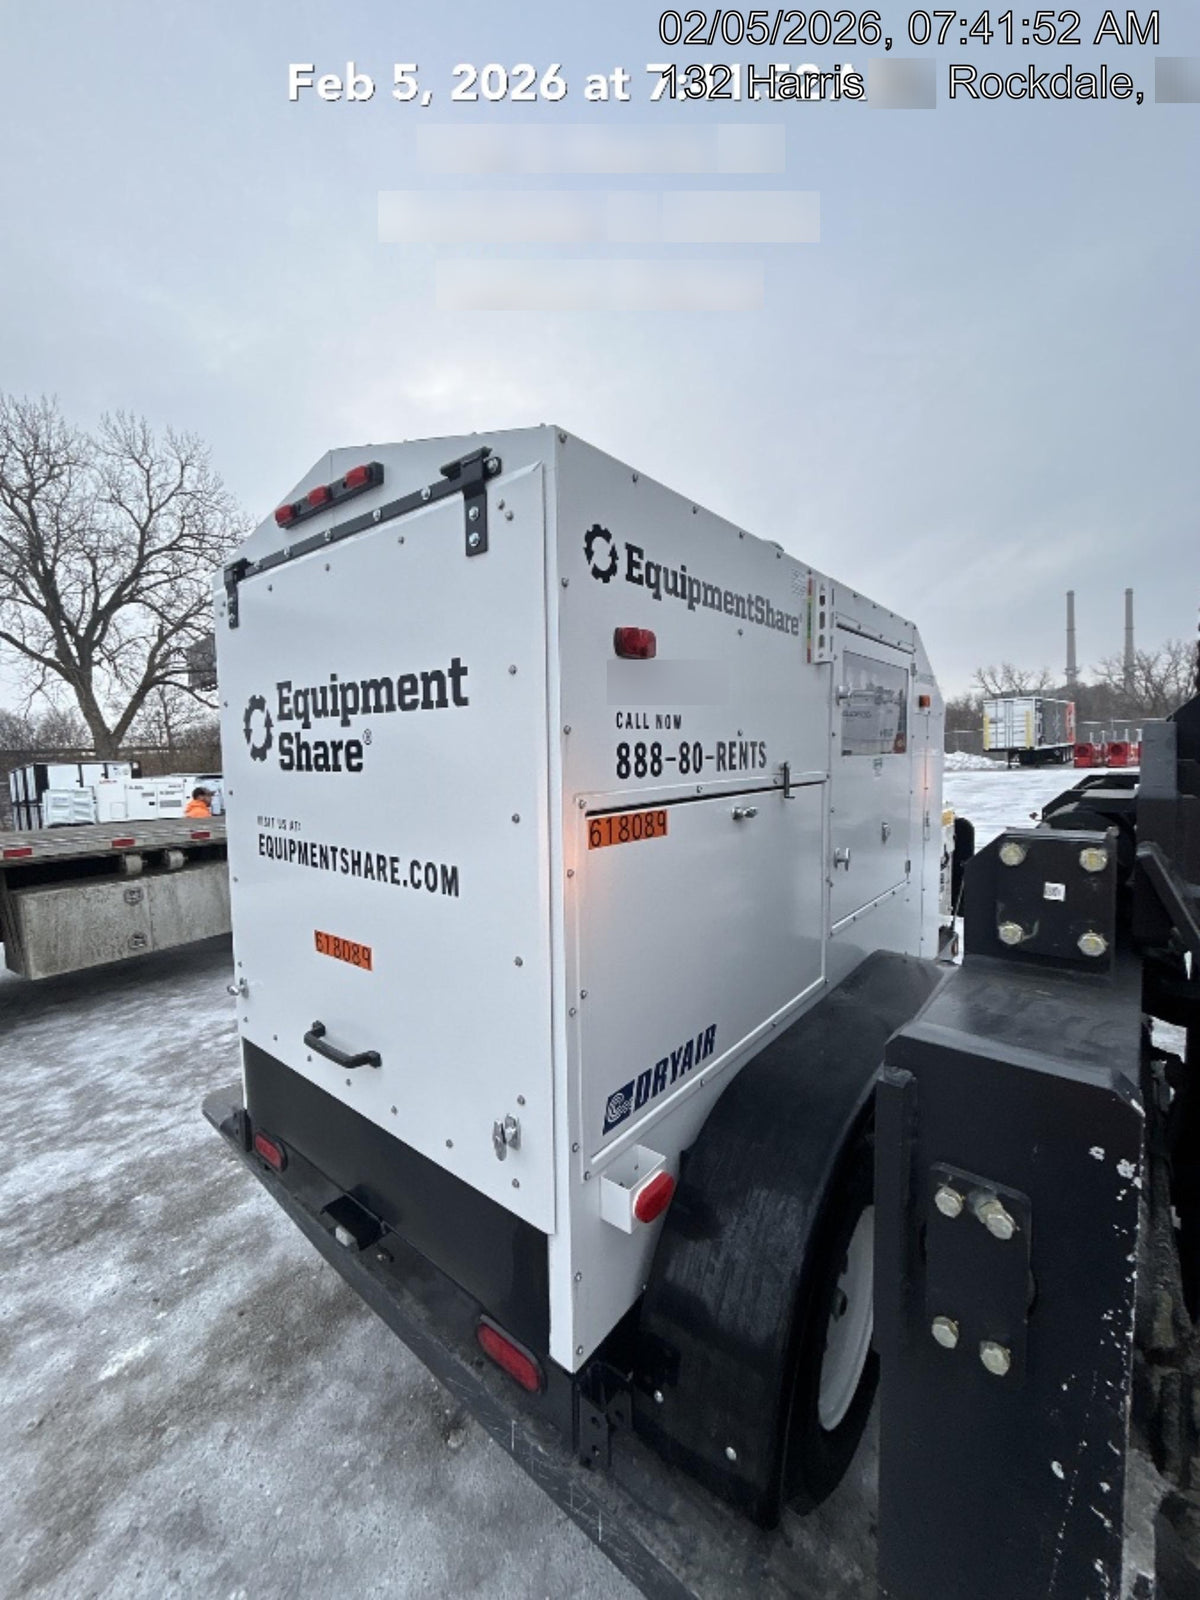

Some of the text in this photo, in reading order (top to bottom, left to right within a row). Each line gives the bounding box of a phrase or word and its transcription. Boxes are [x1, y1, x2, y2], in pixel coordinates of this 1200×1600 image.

[625, 542, 799, 636] EquipmentShare
[276, 657, 469, 729] Equipment
[616, 711, 682, 730] CALL NOW
[616, 741, 768, 780] 888-80-RENTS
[590, 810, 667, 847] 618089
[258, 833, 460, 898] EQUIPMENTSHARE.COM
[315, 931, 372, 971] 618089
[633, 1023, 718, 1113] DRYAIR
